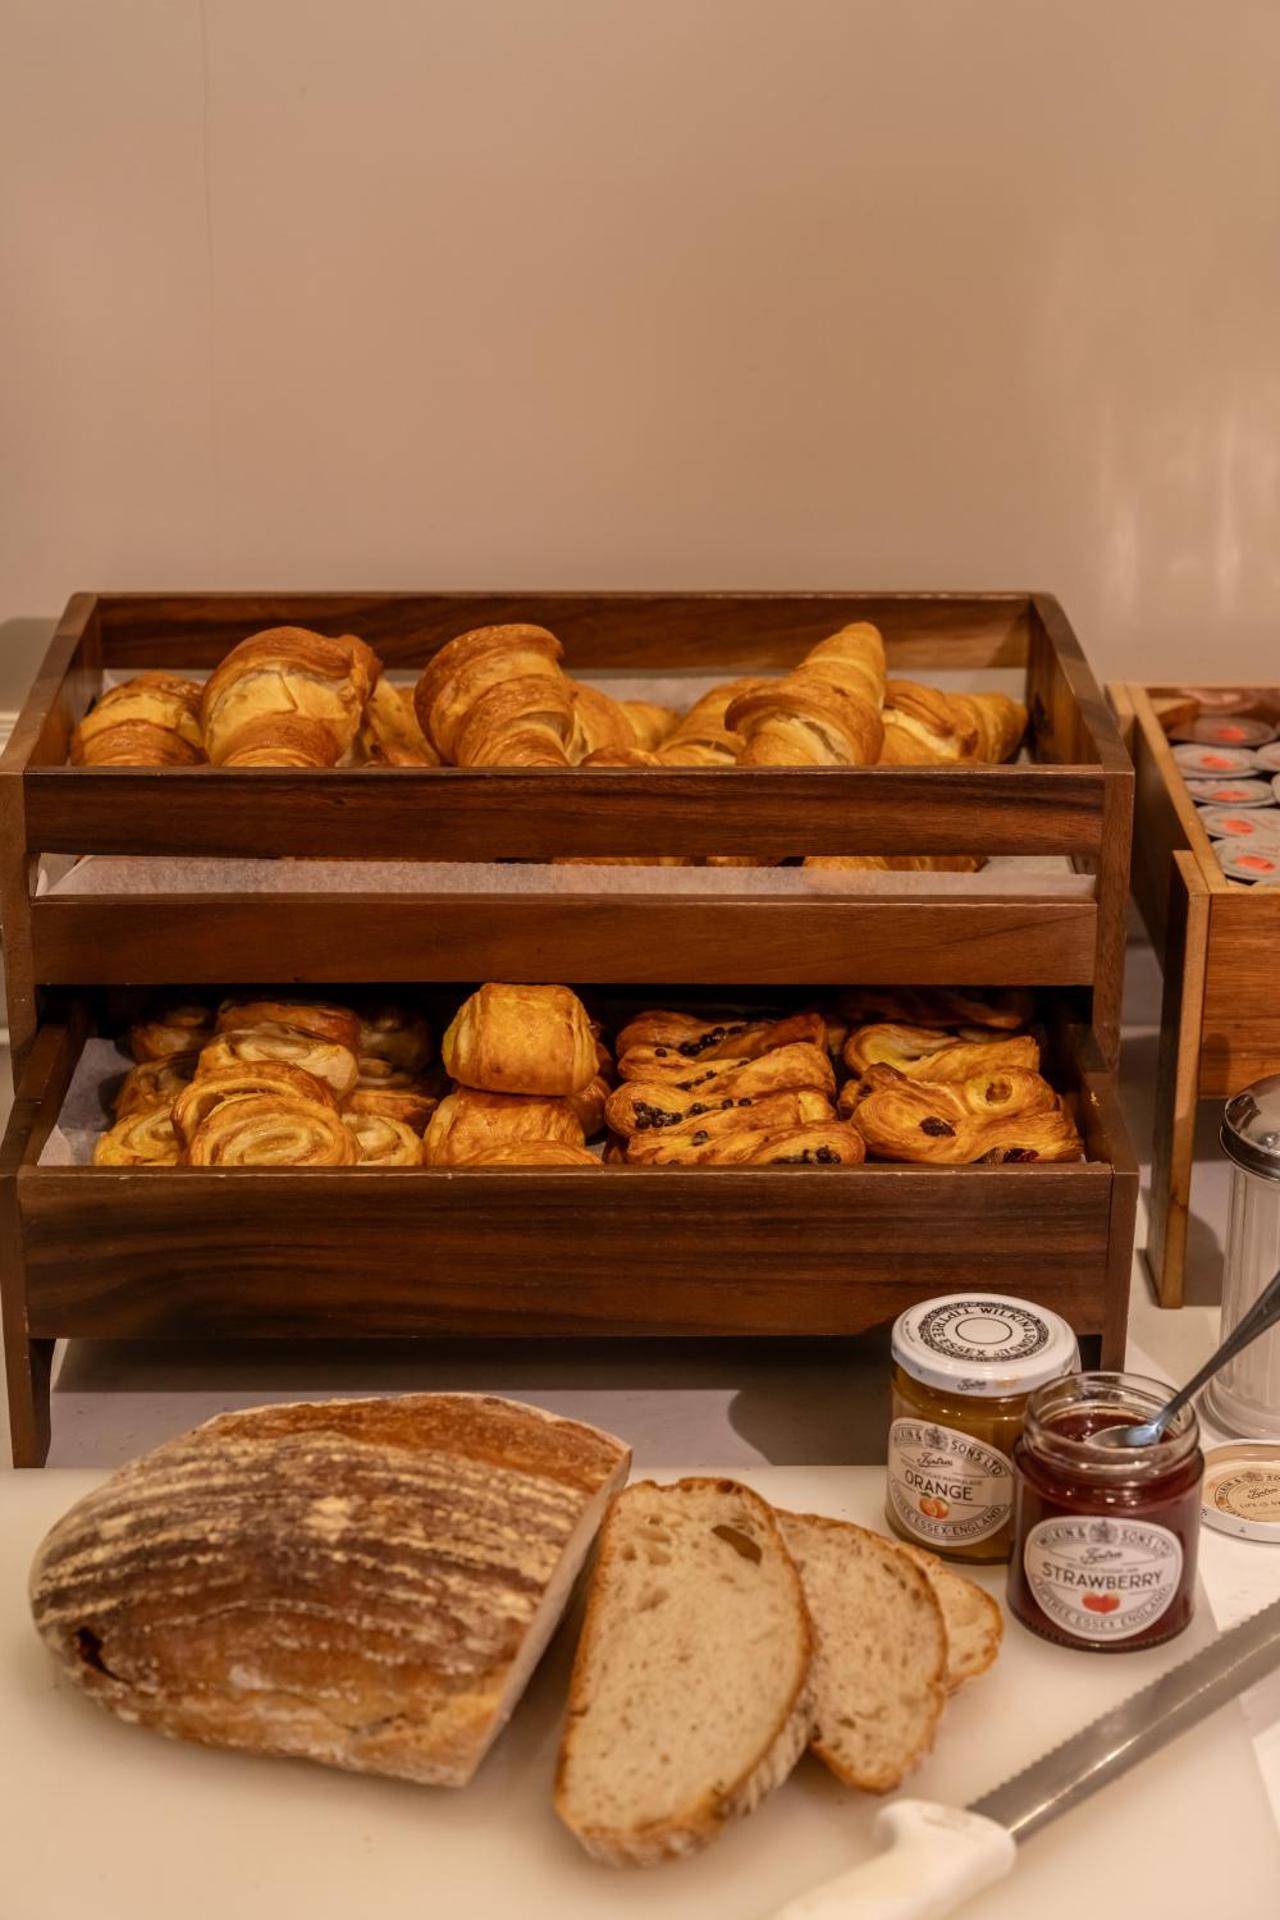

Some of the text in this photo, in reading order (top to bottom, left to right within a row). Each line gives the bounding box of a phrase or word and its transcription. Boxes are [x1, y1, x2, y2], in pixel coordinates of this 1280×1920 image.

[980, 1307, 1032, 1327] WILKIN
[939, 1337, 987, 1357] ESSEX
[951, 1440, 983, 1461] SONS
[984, 1456, 1003, 1476] LTD
[904, 1469, 973, 1501] ORANGE
[953, 1506, 1002, 1534] ENGLAND
[1041, 1562, 1163, 1590] STRAWBERRY
